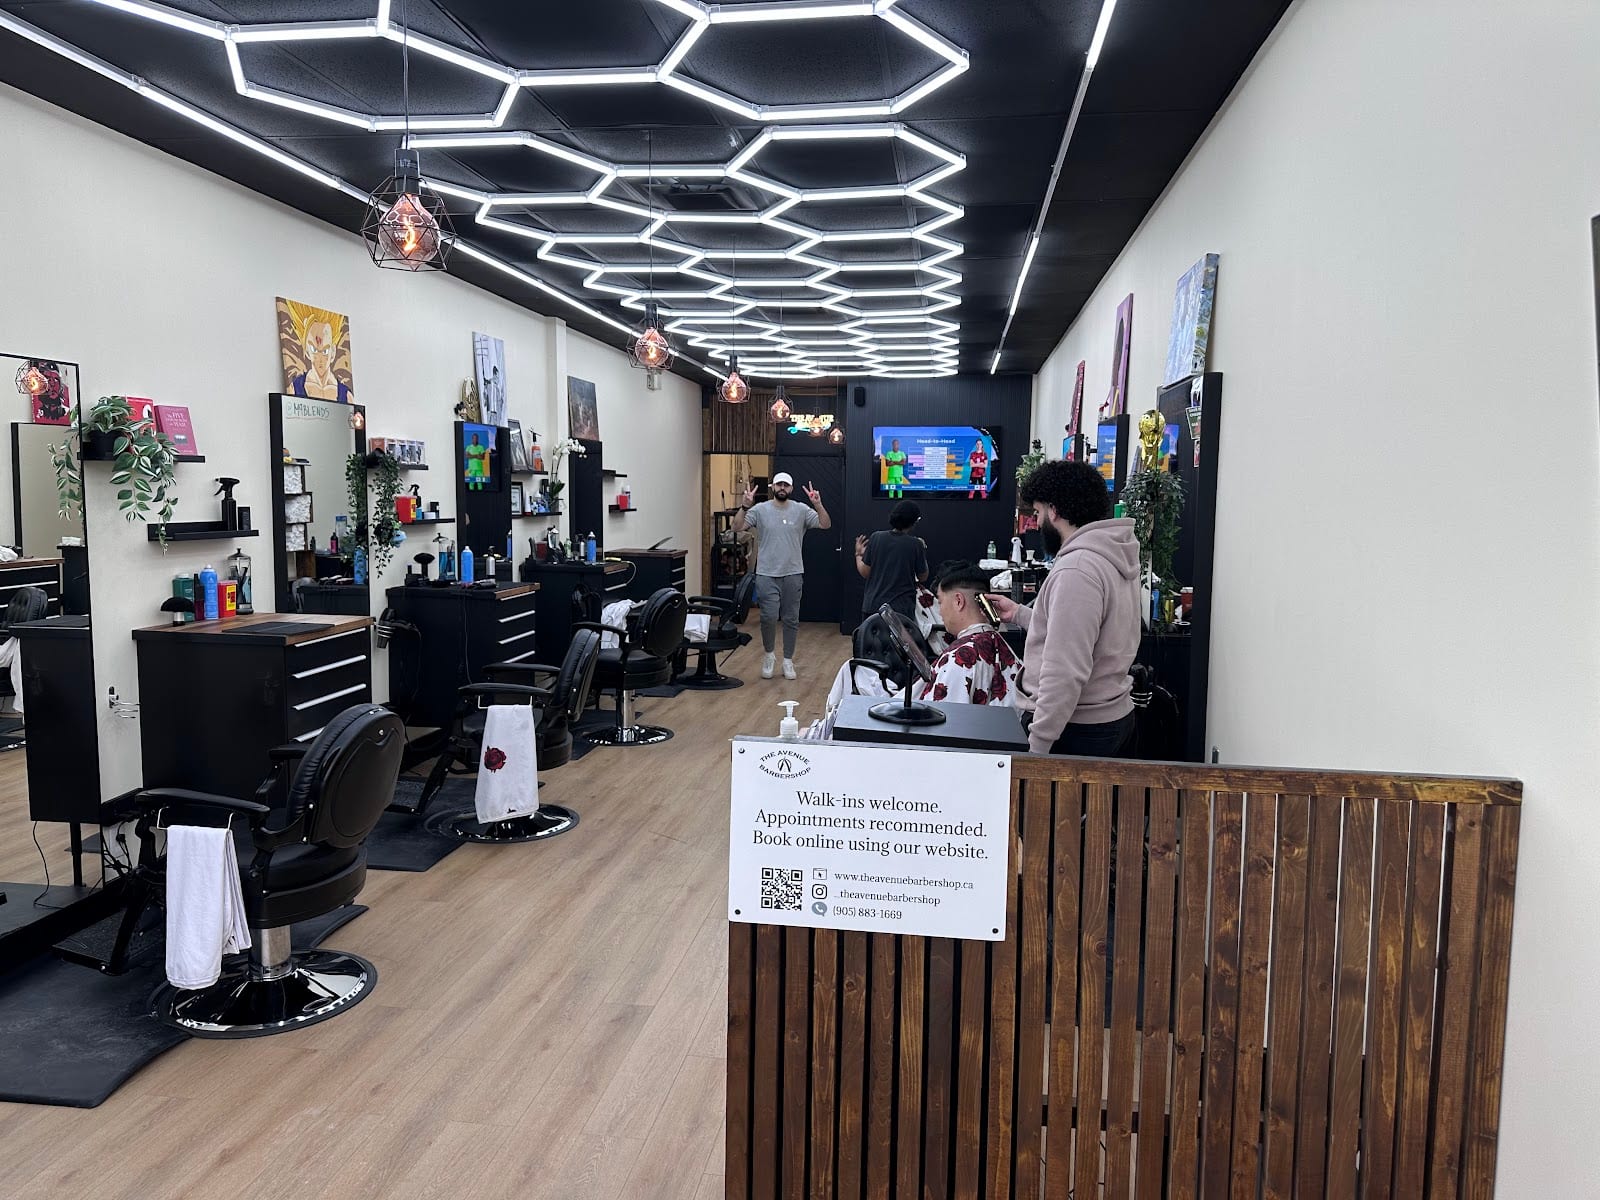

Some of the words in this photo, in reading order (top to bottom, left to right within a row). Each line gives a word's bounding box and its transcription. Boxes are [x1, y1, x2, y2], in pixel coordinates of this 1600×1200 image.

[760, 751, 776, 762] THE
[777, 750, 810, 765] AVENUE
[759, 764, 811, 779] BARBERSHOP
[796, 790, 865, 809] Walk-ins
[869, 796, 942, 814] welcome.
[754, 808, 865, 829] Appointments
[869, 819, 987, 837] recommended.
[753, 830, 792, 847] Book
[796, 834, 844, 850] online
[848, 837, 890, 857] using
[893, 842, 921, 855] our
[925, 842, 989, 860] website.
[834, 872, 974, 891] www.theavenuebarbershop.ca
[832, 905, 856, 917] (905)
[858, 907, 902, 920] 883-1669
